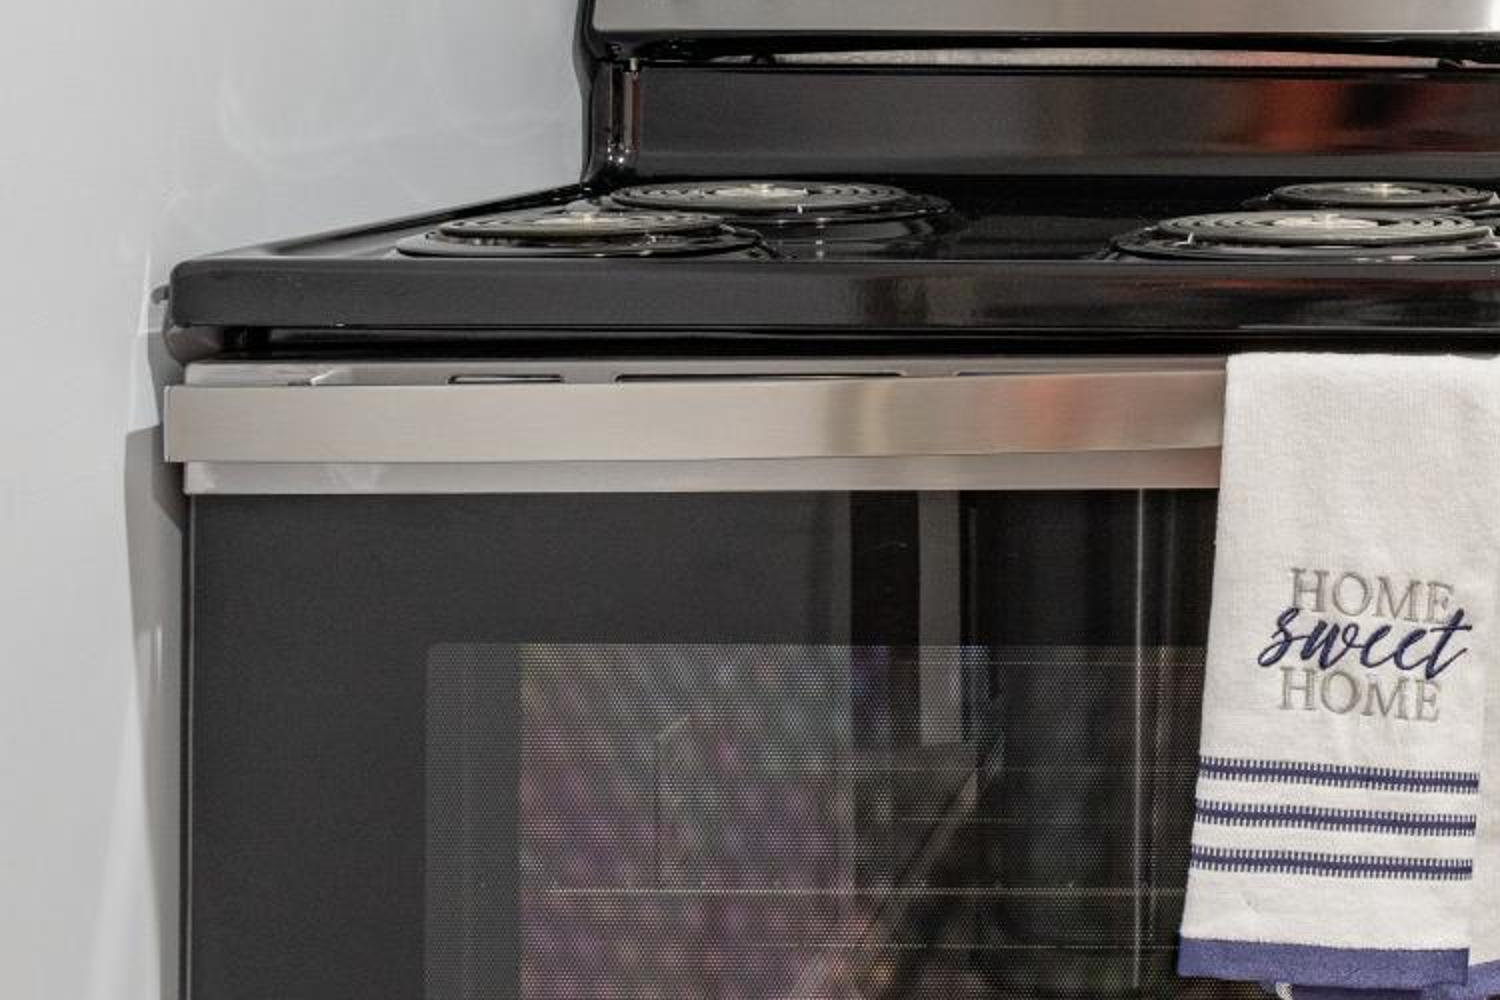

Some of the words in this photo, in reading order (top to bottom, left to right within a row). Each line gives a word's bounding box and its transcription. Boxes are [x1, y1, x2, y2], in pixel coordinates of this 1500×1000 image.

[1289, 567, 1454, 624] HOME
[1257, 607, 1473, 680] sweet
[1280, 667, 1442, 722] HOME
